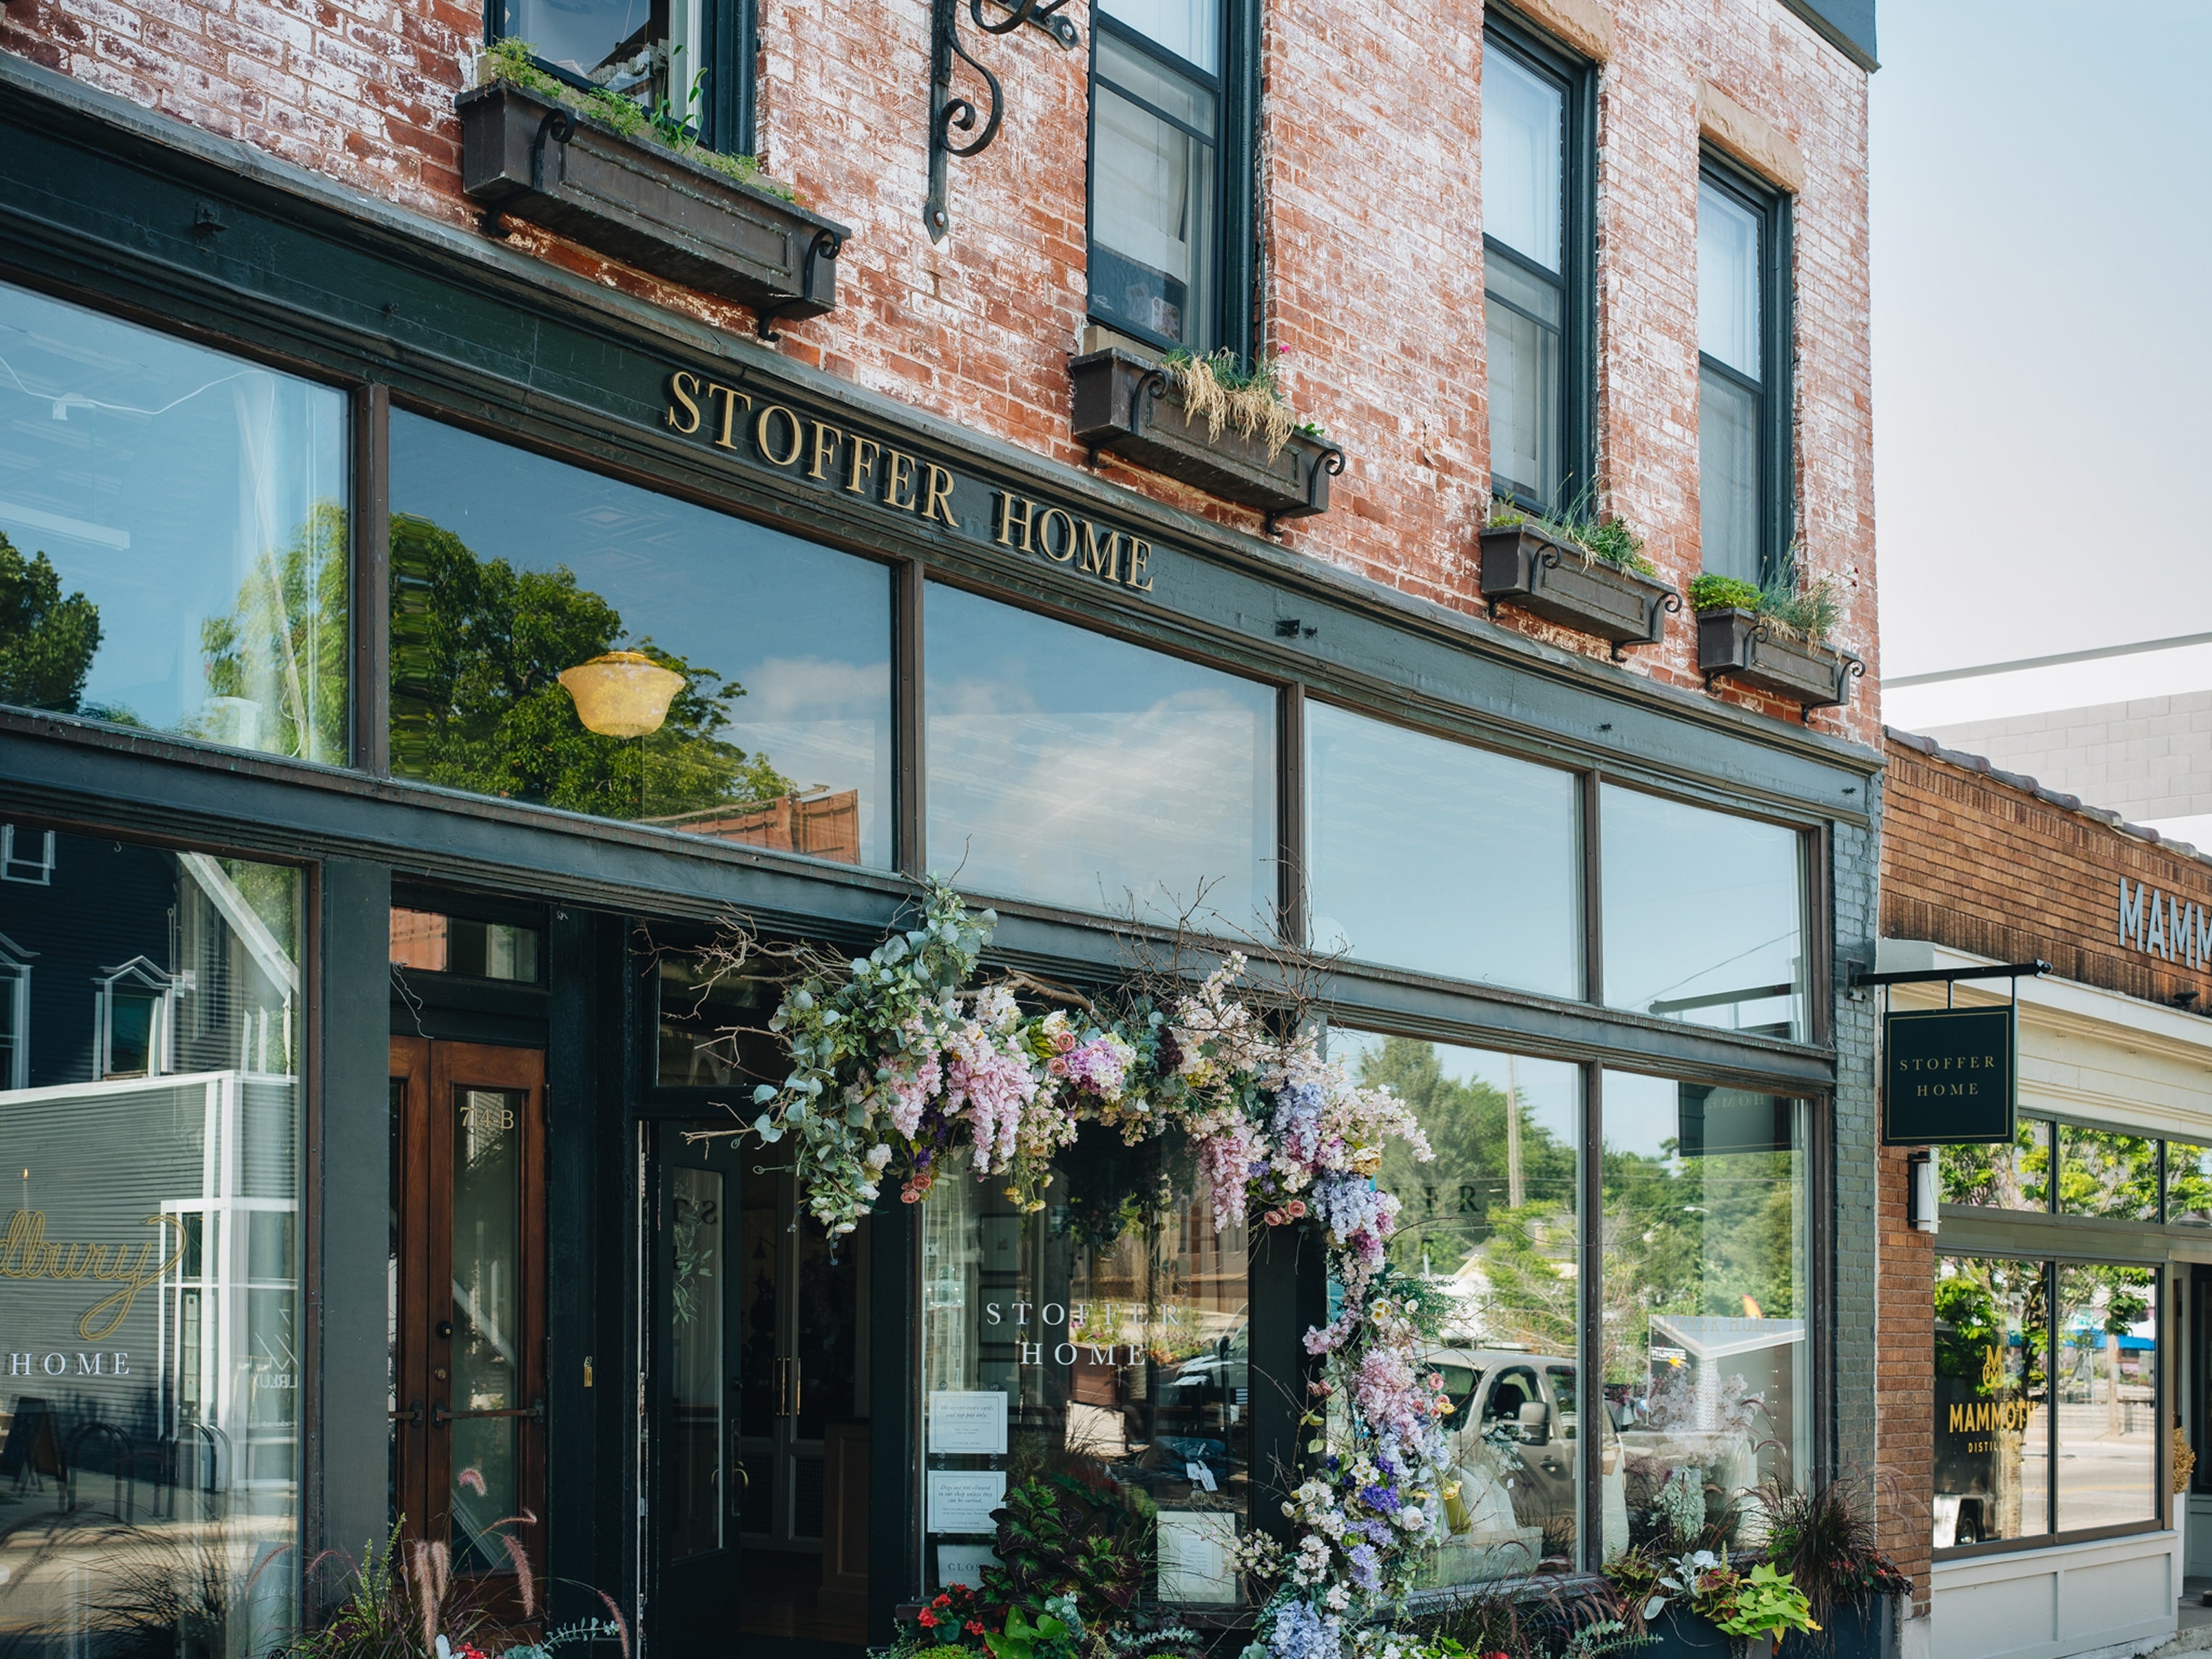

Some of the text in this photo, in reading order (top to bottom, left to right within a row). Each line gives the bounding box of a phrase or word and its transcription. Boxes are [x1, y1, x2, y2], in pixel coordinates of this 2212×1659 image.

[667, 371, 1154, 592] STOFFER HOME
[1899, 1056, 1996, 1072] STOFFER
[1917, 1083, 1979, 1097] HOME
[459, 1107, 514, 1129] 714-B
[986, 1303, 1181, 1327] STOFFER
[10, 1352, 130, 1375] HOME
[1020, 1342, 1147, 1366] HOME
[1949, 1401, 2038, 1433] MAMMOTH
